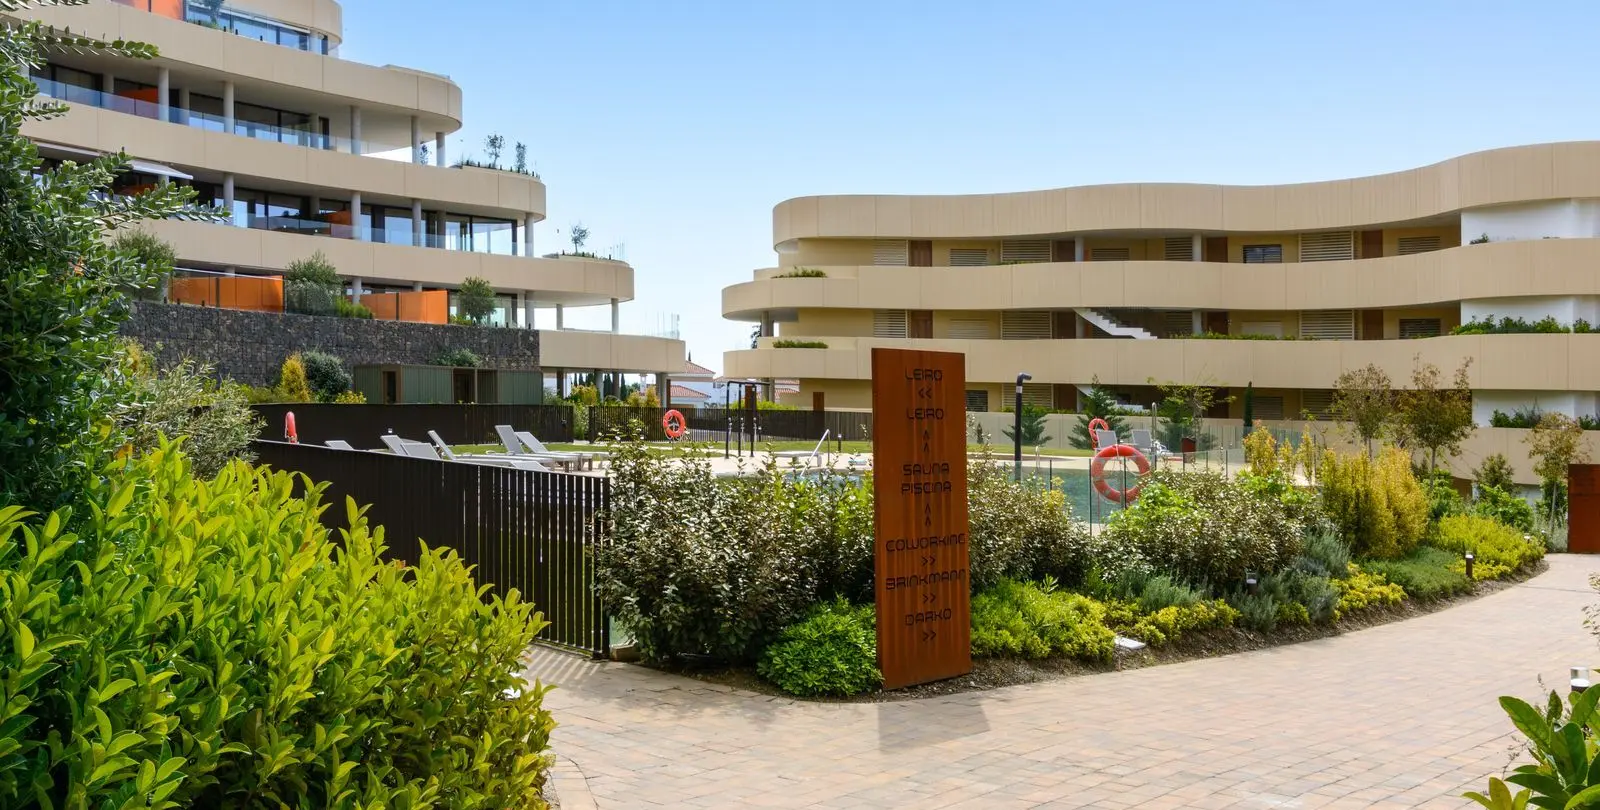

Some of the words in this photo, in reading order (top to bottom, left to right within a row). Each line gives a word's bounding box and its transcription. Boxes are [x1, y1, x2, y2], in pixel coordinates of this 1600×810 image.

[905, 368, 942, 381] LEIRO
[906, 407, 944, 420] LEIRO
[903, 463, 950, 476] SAUNA
[901, 481, 952, 495] PISCINA
[886, 533, 966, 552] COWORKING
[886, 569, 966, 590] BRINKMANN
[905, 608, 952, 626] DARKO
